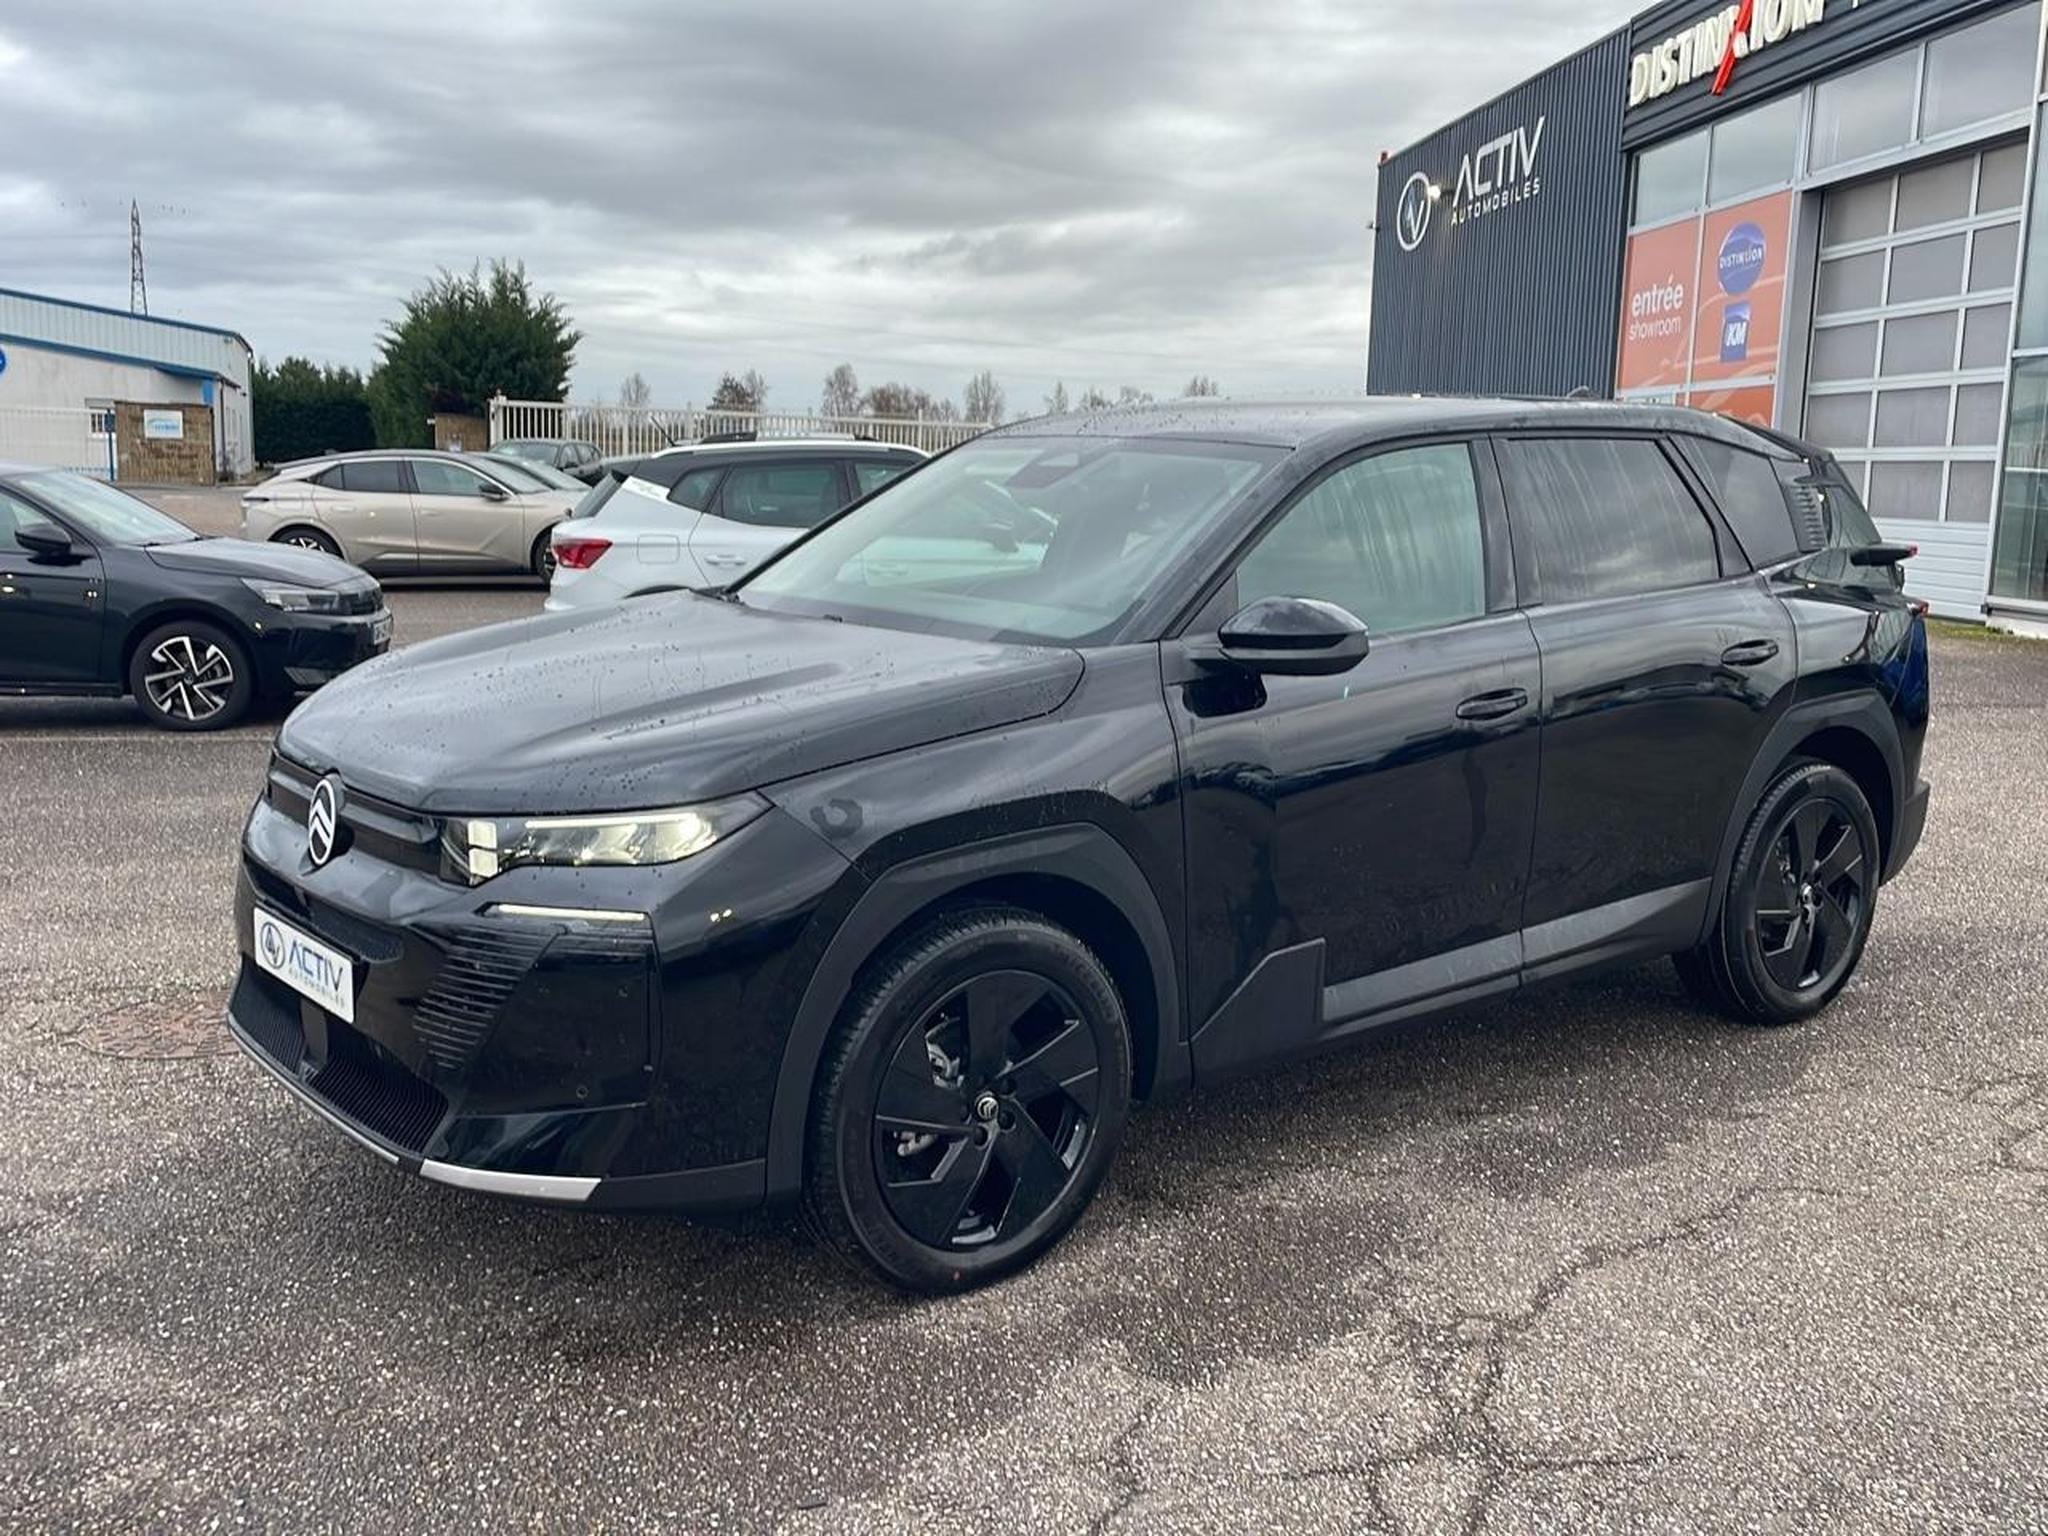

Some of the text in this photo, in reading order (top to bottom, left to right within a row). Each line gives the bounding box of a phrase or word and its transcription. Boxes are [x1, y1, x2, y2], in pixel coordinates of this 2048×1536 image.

[1452, 115, 1545, 208] ACTIV
[1451, 178, 1541, 227] AUTOMOBILES
[1631, 273, 1684, 317] entrée
[1629, 316, 1682, 341] showroom
[289, 939, 343, 992] ACTIV
